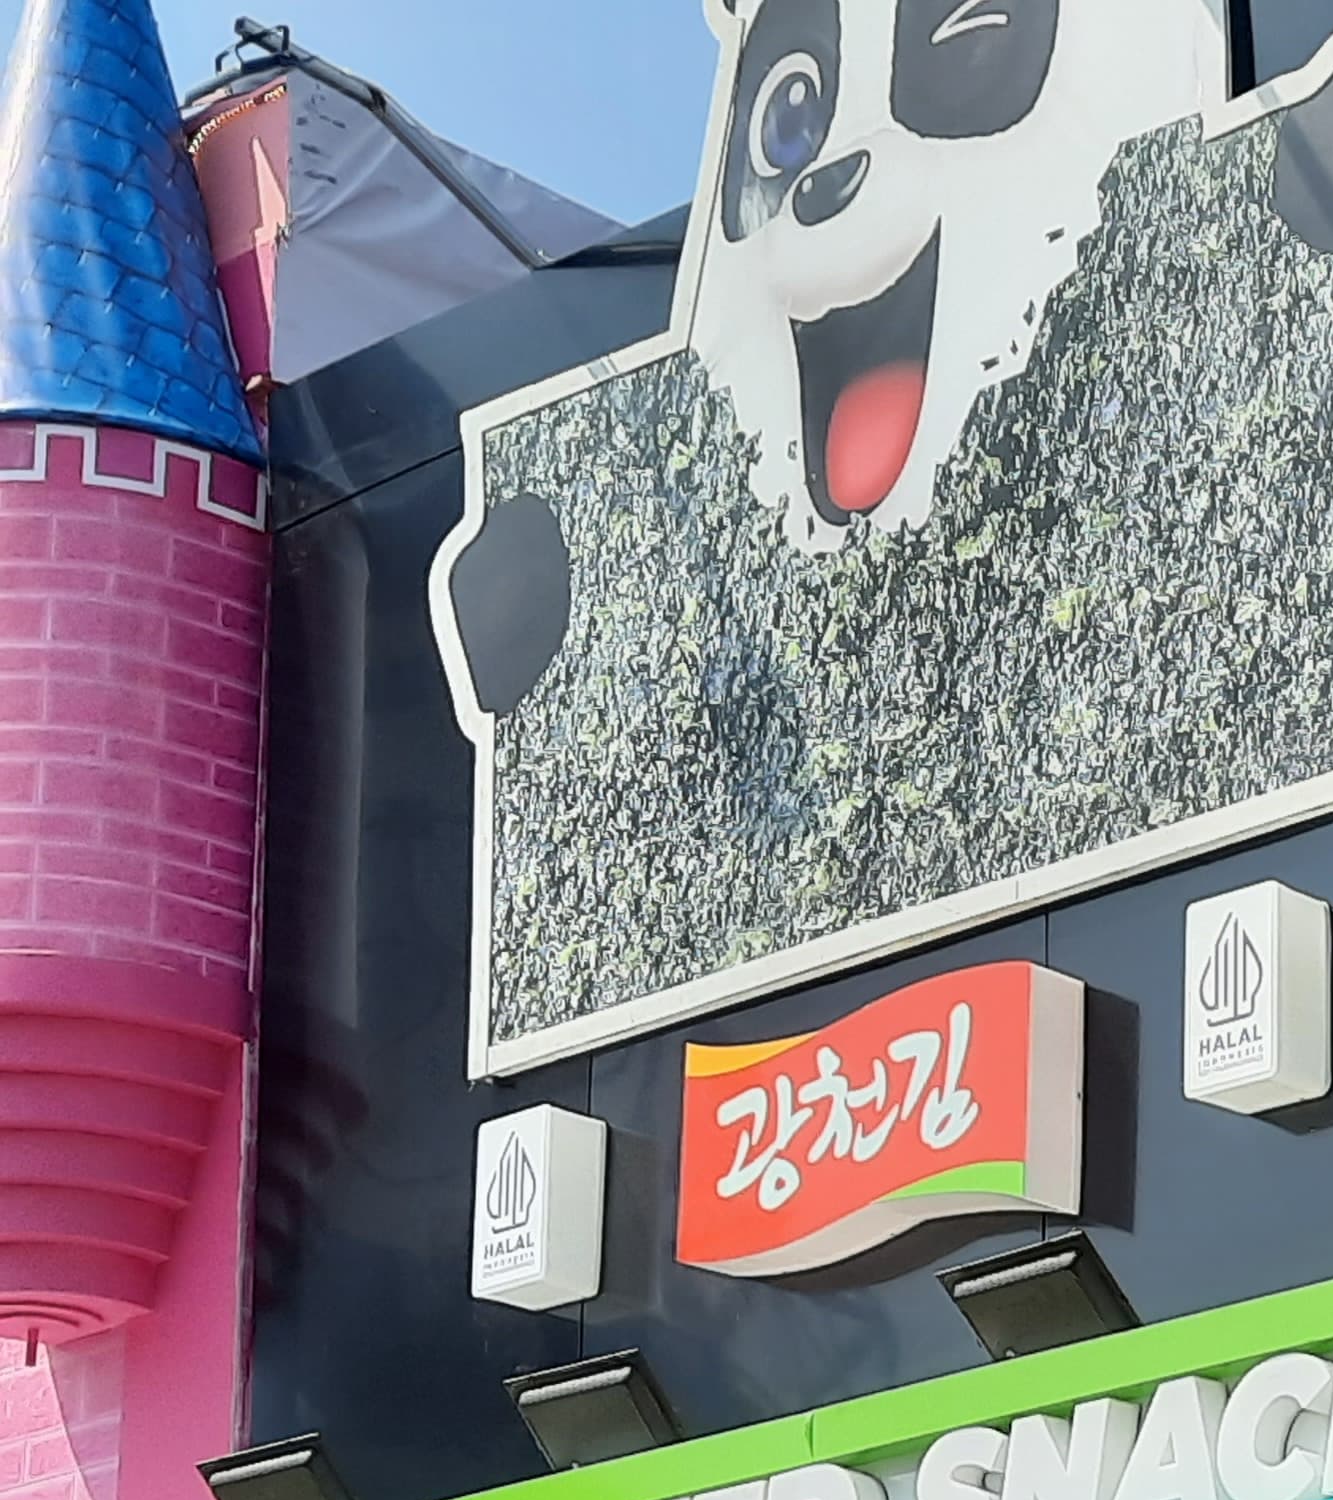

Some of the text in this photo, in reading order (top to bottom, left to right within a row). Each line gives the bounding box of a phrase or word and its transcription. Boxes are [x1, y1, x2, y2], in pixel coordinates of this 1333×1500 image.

[1199, 1023, 1263, 1057] HALAL
[716, 1002, 979, 1210] 광천김
[484, 1231, 535, 1260] HALAL
